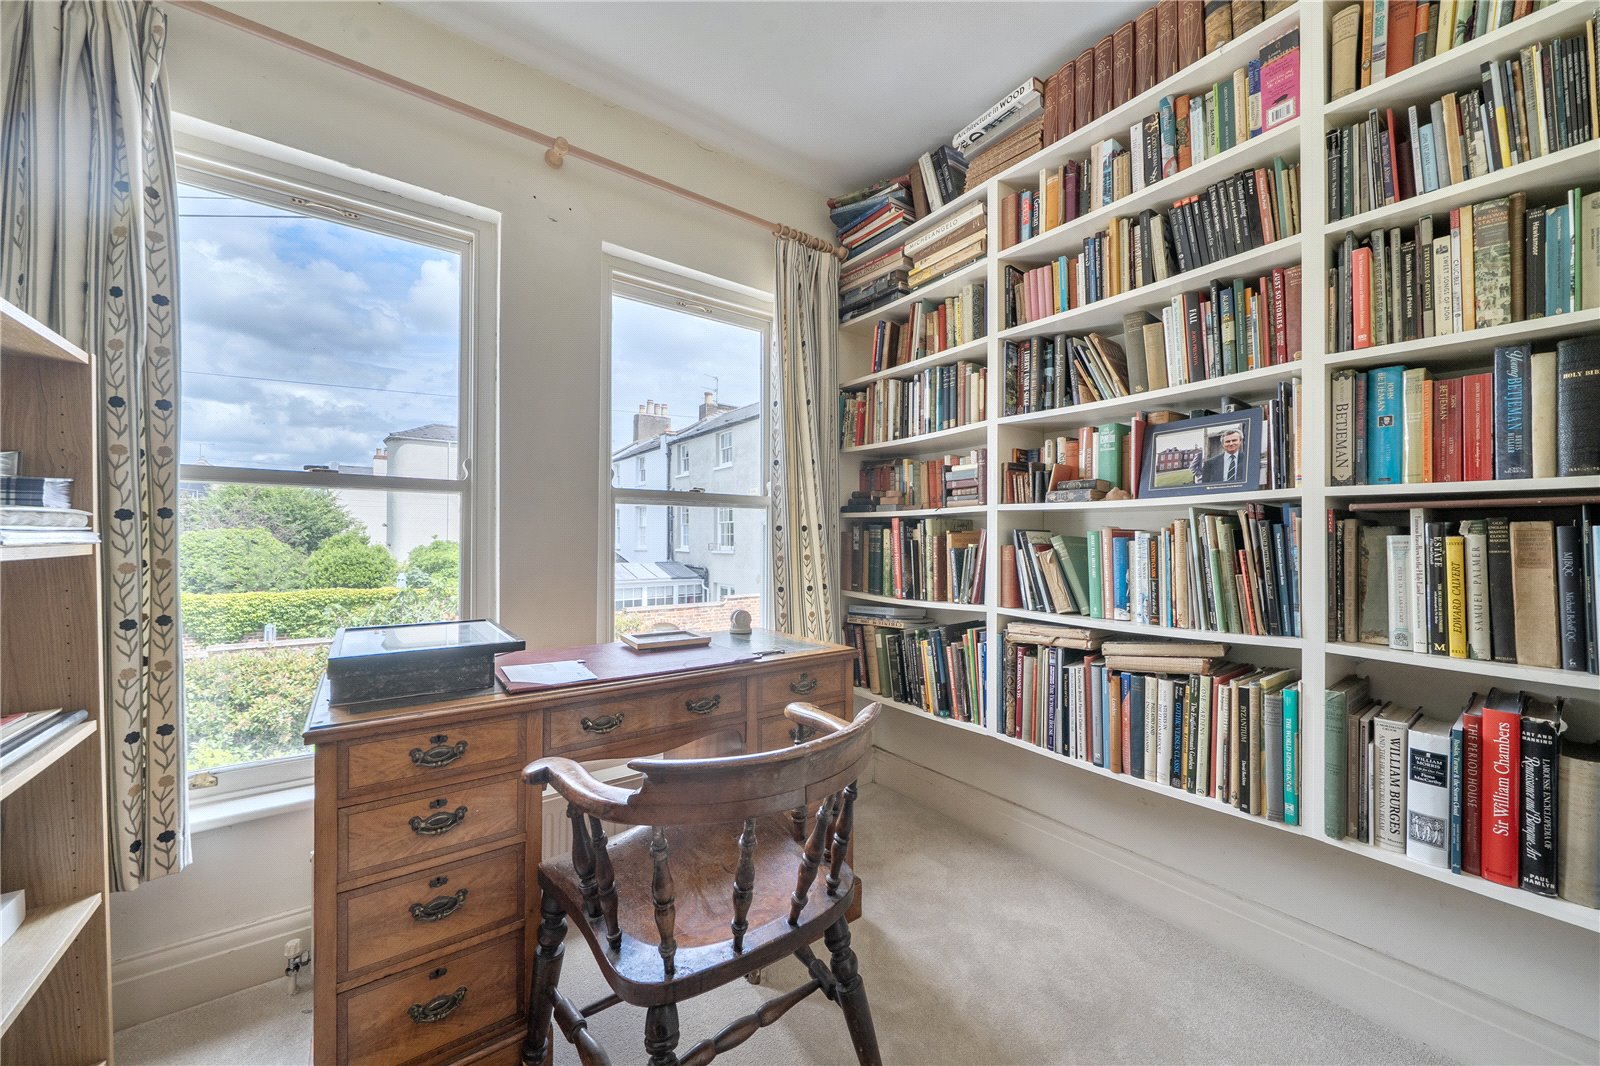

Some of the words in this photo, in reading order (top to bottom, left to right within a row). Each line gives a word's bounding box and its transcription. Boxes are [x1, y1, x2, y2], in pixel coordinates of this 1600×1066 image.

[957, 113, 992, 138] Architecture
[992, 107, 999, 115] in
[999, 86, 1025, 108] WOOD
[1474, 211, 1508, 221] RAILWAY
[1478, 216, 1508, 226] STATION
[909, 219, 958, 249] MICHELANGELO
[1233, 217, 1241, 244] Architecture
[1532, 221, 1540, 256] Hawksmoor
[1275, 290, 1281, 300] SO
[1188, 308, 1198, 325] FALL
[1223, 313, 1230, 321] DE
[1275, 301, 1283, 329] STORIES
[1505, 349, 1524, 378] Young
[1563, 371, 1583, 379] HOLY
[1377, 372, 1386, 412] BETJEMAN
[1439, 384, 1448, 420] BETJEMAN
[1504, 377, 1523, 431] BETJEMAN
[1335, 403, 1349, 468] BETJEMAN
[1507, 432, 1515, 454] HILLIER
[1434, 536, 1443, 568] ESTATE
[1562, 551, 1574, 577] MJBQC
[1413, 570, 1423, 582] Holy
[1450, 561, 1462, 596] CALVERT
[1471, 547, 1482, 585] PALMER
[1416, 581, 1424, 595] Land
[1452, 598, 1463, 634] EDWARD
[1473, 593, 1484, 632] SAMUEL
[1565, 592, 1575, 614] Michael
[1566, 614, 1577, 632] Beloff
[1433, 643, 1447, 651] M
[1565, 631, 1576, 643] QC
[1163, 721, 1167, 730] IN
[1467, 723, 1478, 740] THE
[1492, 722, 1511, 775] Chambers
[1522, 735, 1553, 745] MANKIND
[1389, 737, 1401, 788] WILLIAM
[1414, 755, 1443, 765] WILLIAM
[1416, 760, 1441, 769] MORRIS
[1467, 742, 1478, 776] PERIOD
[1414, 775, 1442, 786] MacCarthy
[1521, 756, 1541, 797] Renaissance
[1541, 758, 1551, 792] LAROUSSE
[1378, 776, 1386, 809] VICTORIAN
[1467, 777, 1478, 808] HOUSE
[1492, 777, 1510, 818] William
[1389, 789, 1401, 835] BURGES
[1453, 802, 1461, 816] Cloud
[1525, 797, 1540, 815] and
[1542, 792, 1552, 840] ENCYCLOPEDIA
[1492, 819, 1509, 837] Sir
[1521, 812, 1541, 843] Baroque
[1526, 842, 1542, 861] Art
[1544, 840, 1553, 850] OF
[1523, 876, 1555, 889] HAMLYN
[1529, 872, 1550, 884] PAUL
